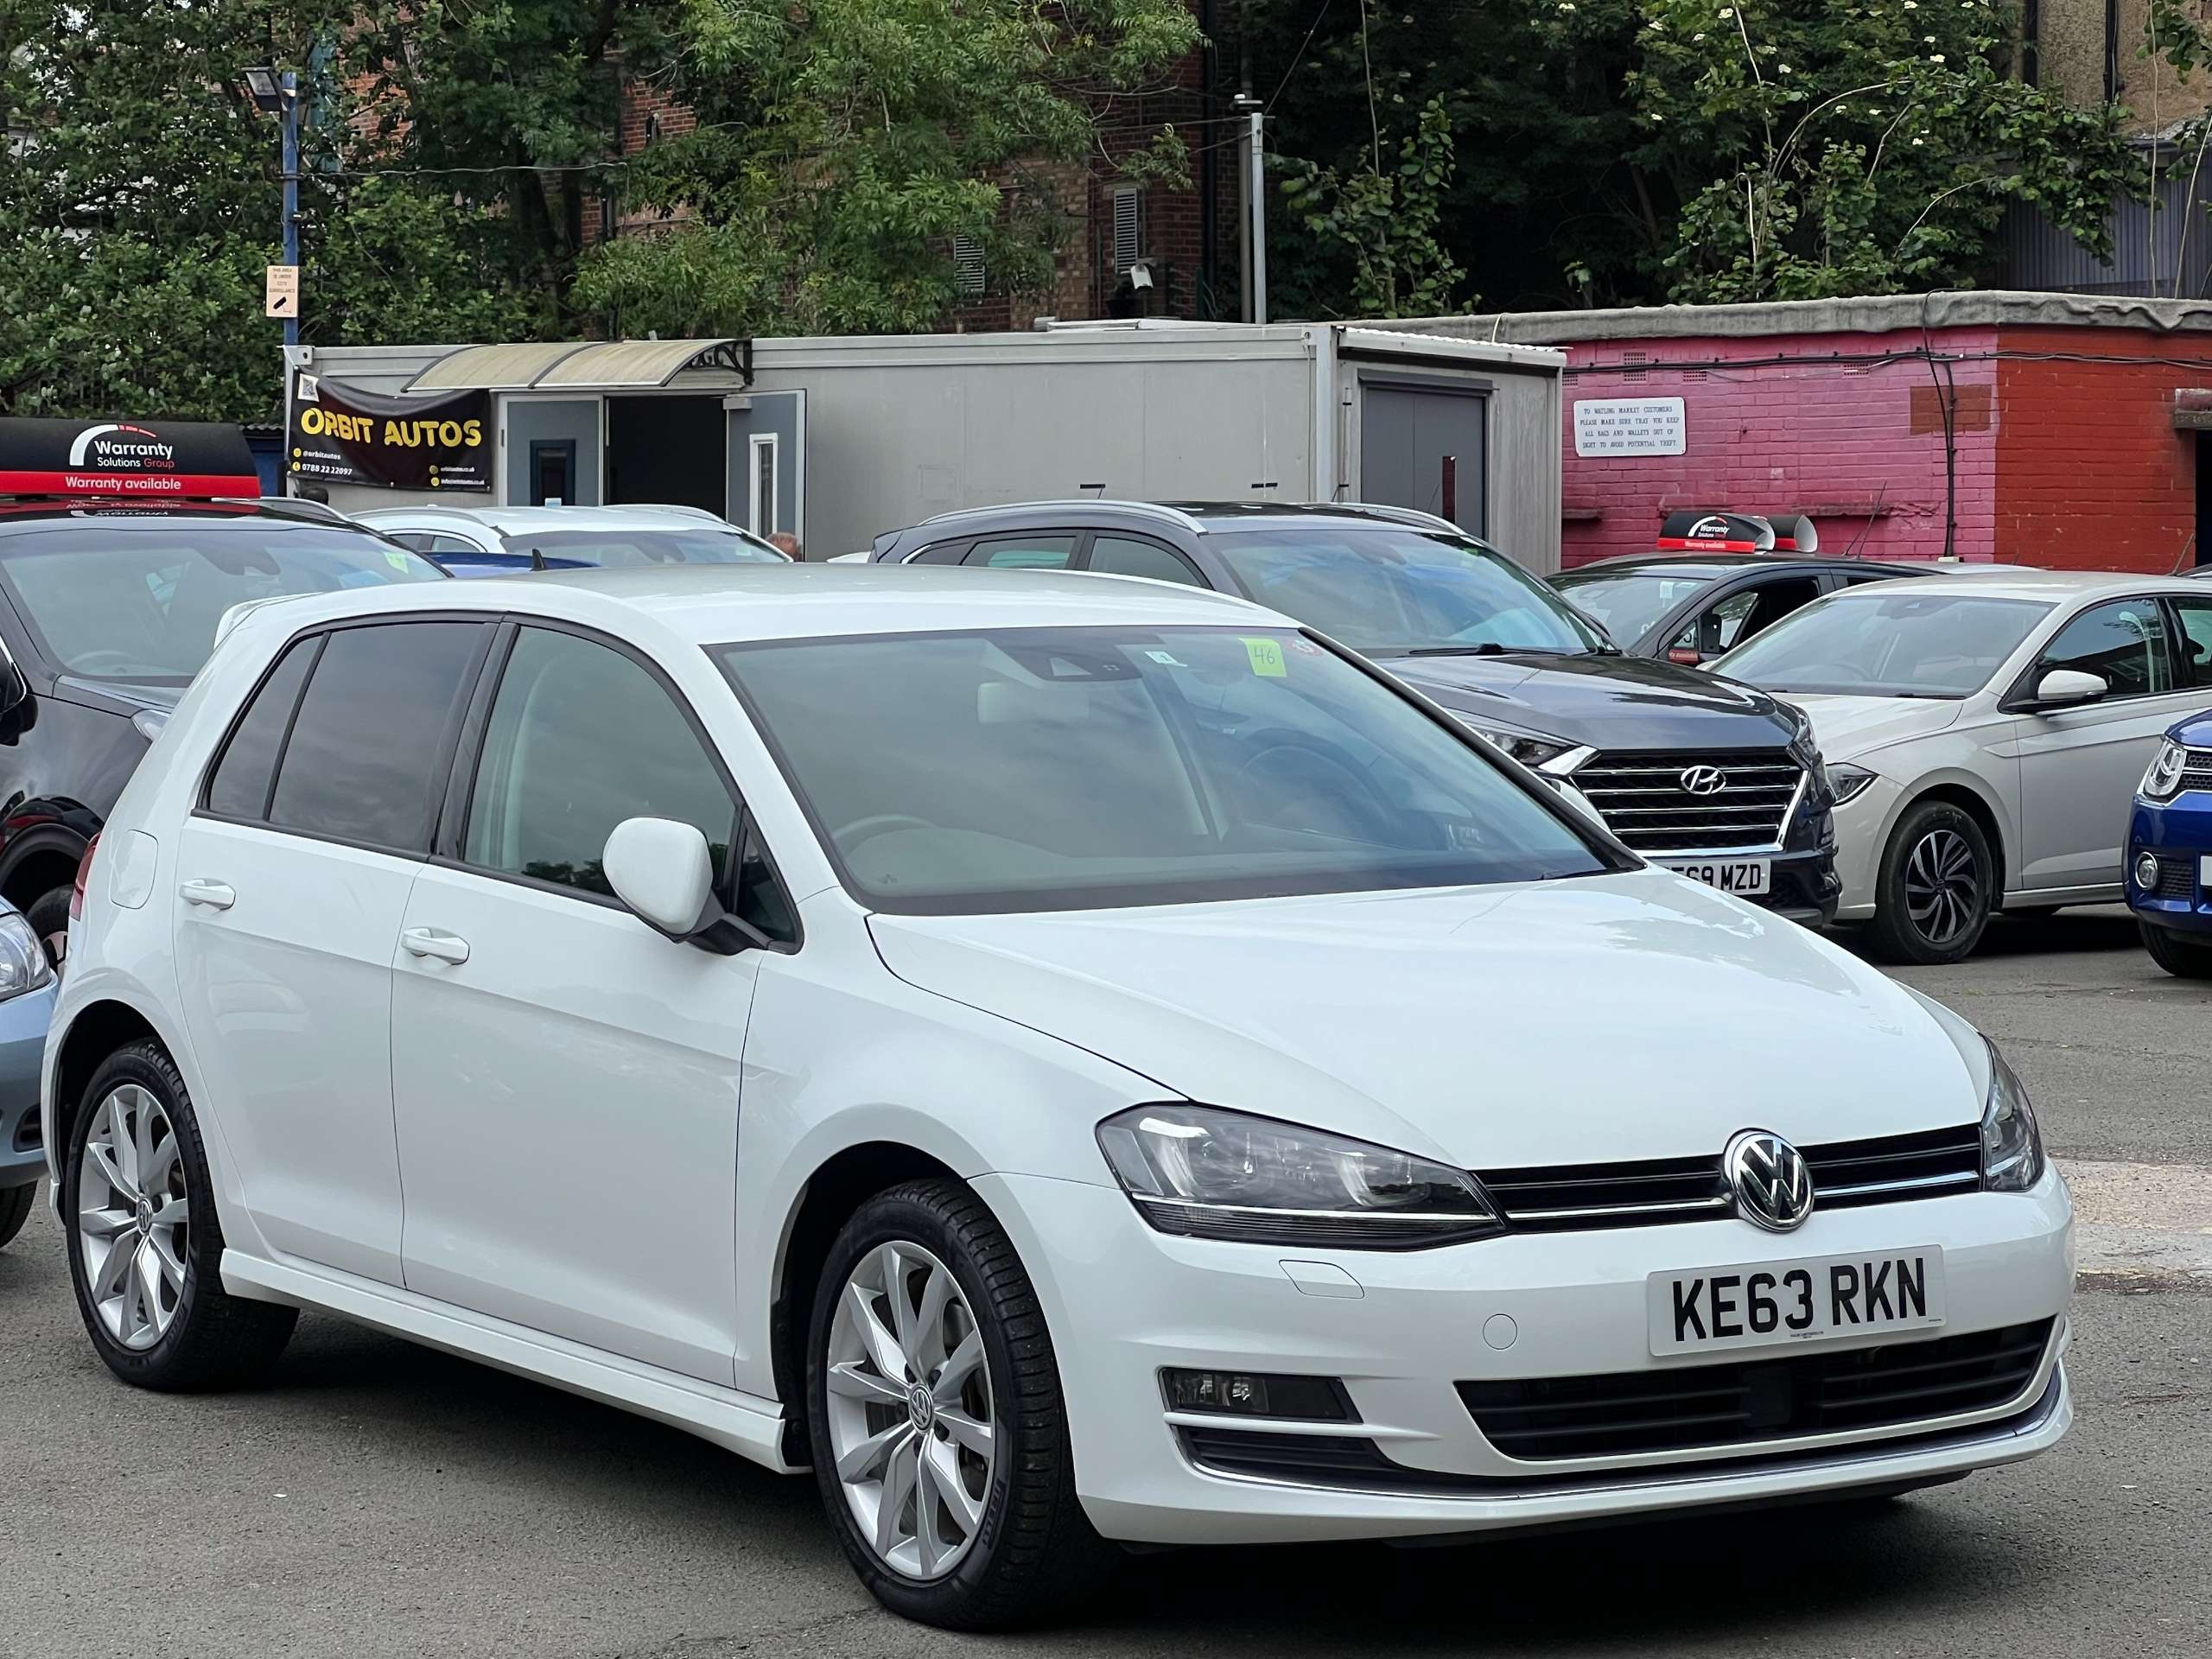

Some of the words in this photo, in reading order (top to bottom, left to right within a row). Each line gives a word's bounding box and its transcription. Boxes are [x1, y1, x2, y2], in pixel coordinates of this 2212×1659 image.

[301, 407, 373, 444] ORBIT
[384, 419, 482, 448] AUTOS
[94, 441, 173, 460] Warranty
[302, 450, 340, 460] @orbitautos
[97, 457, 141, 467] Solutions
[143, 459, 175, 468] Group
[331, 467, 353, 475] 22097
[66, 476, 122, 491] Warranty
[125, 478, 181, 490] available
[1700, 524, 1730, 535] Warranty
[1254, 647, 1275, 664] 46
[1720, 864, 1761, 891] MZD
[1672, 1269, 1815, 1343] KE63
[1829, 1257, 1927, 1325] RKN
